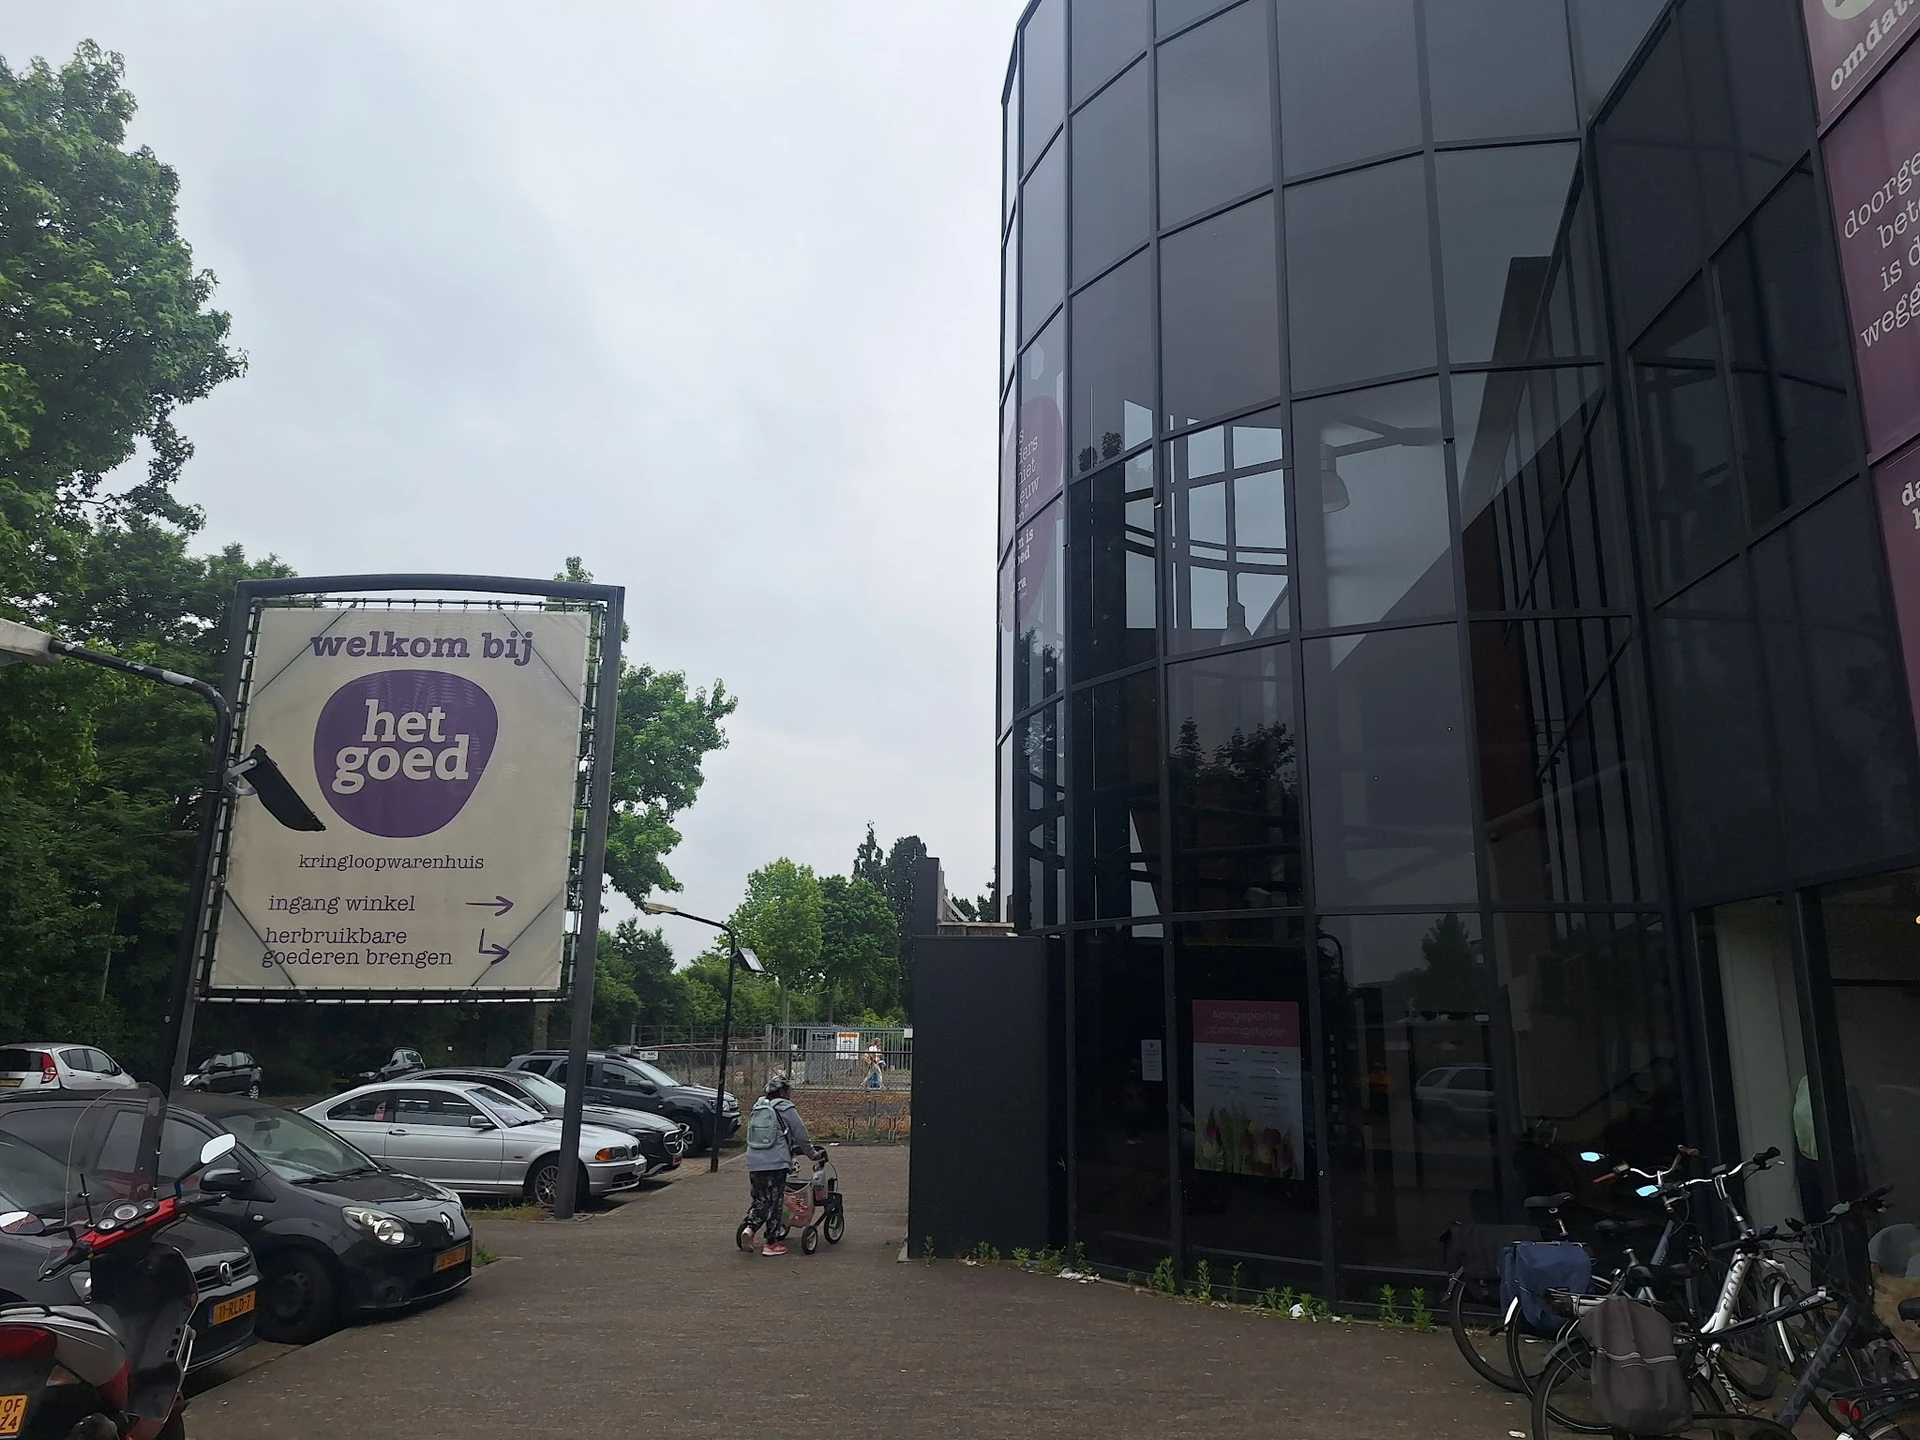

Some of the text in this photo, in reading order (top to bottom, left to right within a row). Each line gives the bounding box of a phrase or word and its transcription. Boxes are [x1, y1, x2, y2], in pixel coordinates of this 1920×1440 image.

[1877, 196, 1920, 249] bet
[1880, 259, 1902, 292] is
[310, 630, 534, 666] welkom bij
[362, 699, 447, 743] het
[331, 734, 470, 795] goed
[298, 853, 485, 873] kringloopwarenhuis
[268, 894, 416, 914] ingang winkel
[264, 928, 408, 944] herbruikbare
[262, 949, 454, 969] goederen brengen
